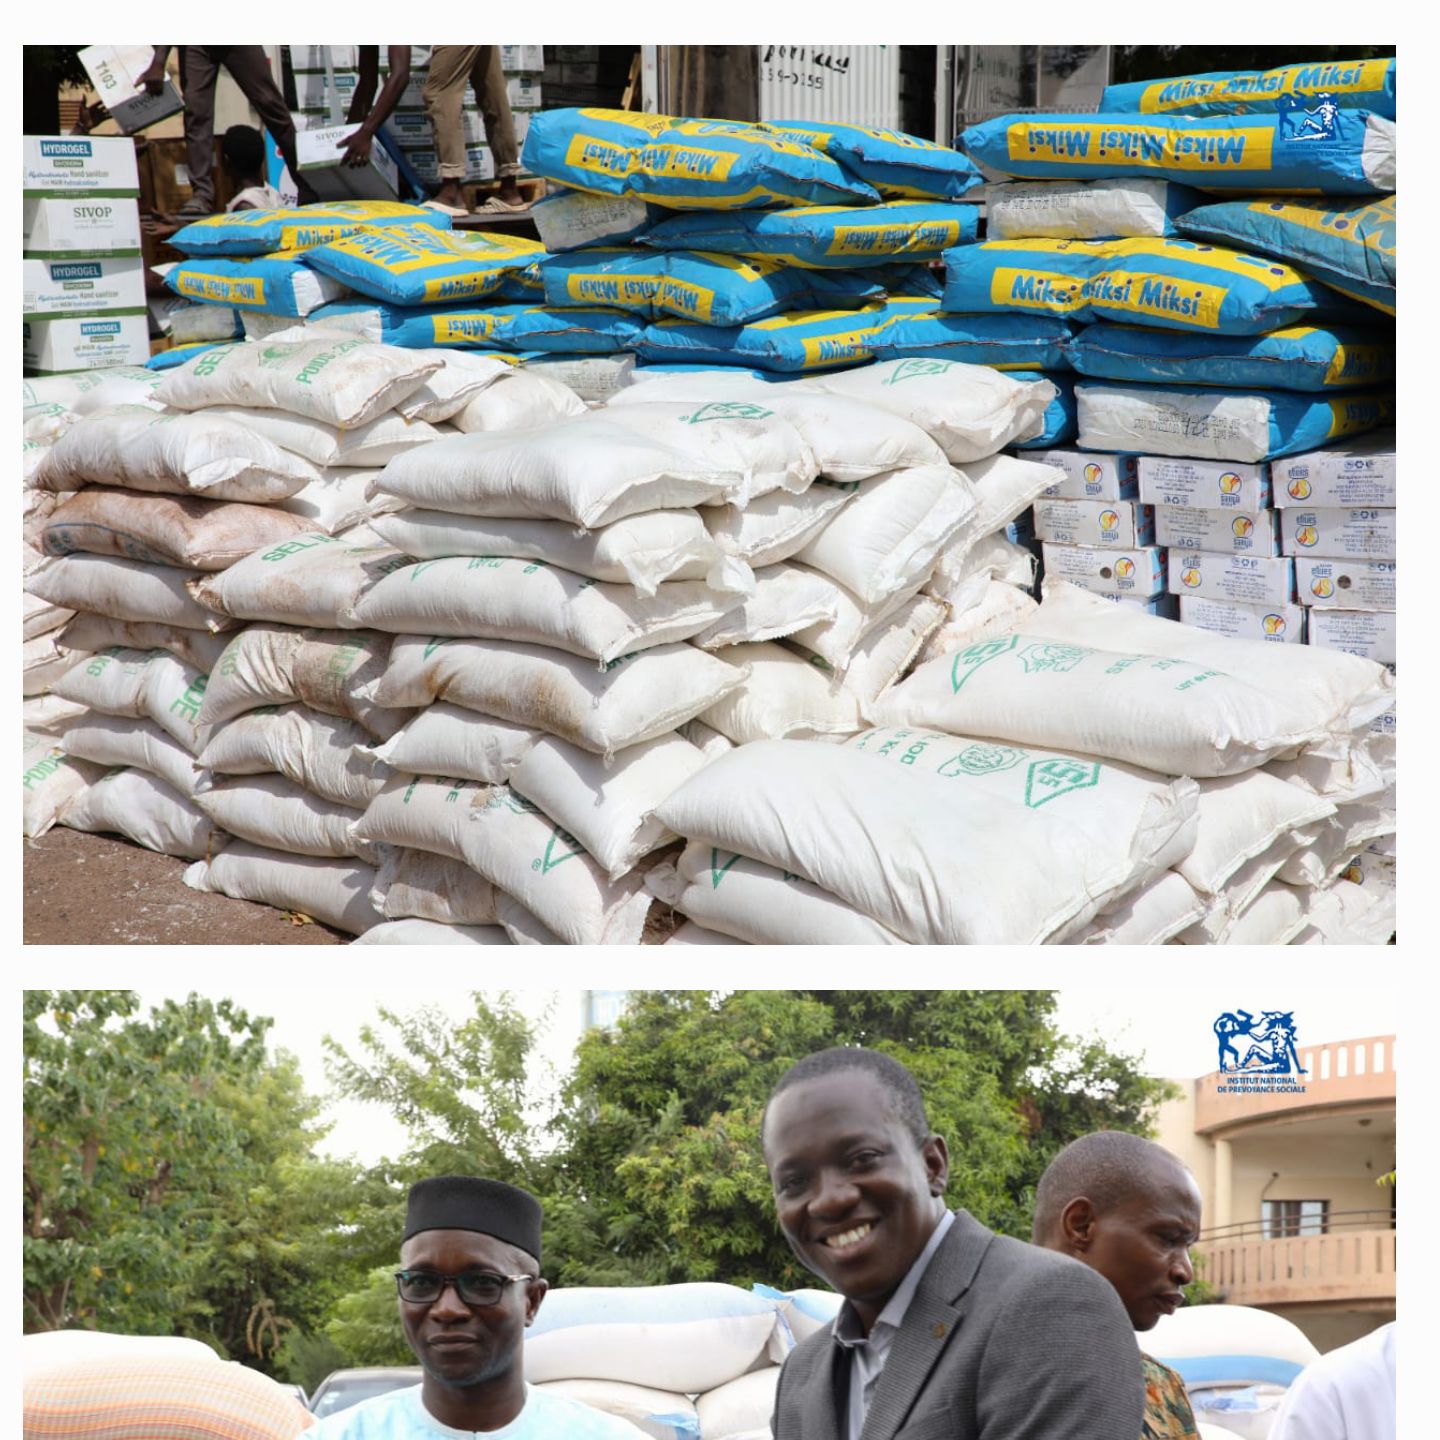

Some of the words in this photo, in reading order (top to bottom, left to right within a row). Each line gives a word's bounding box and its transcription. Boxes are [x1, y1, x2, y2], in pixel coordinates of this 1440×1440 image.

[1159, 79, 1216, 103] Miksi
[1293, 63, 1362, 89] Miksi
[43, 143, 90, 154] HYDROGEL
[1028, 130, 1091, 157] Miksi
[1098, 130, 1167, 159] Miksi
[1173, 134, 1246, 164] Miksi
[582, 143, 632, 172] Miksi
[671, 147, 720, 175] Miksi
[73, 206, 112, 218] SIVOP
[296, 229, 334, 246] Miksi
[52, 265, 99, 277] HYDROGEL
[439, 278, 478, 297] Miksi
[580, 280, 619, 300] Miksi
[663, 283, 699, 309] Miksi
[1012, 273, 1078, 304] Miksi
[1138, 280, 1203, 317] Miksi
[82, 323, 118, 333] HYDROGEL
[448, 320, 487, 337] Miksi
[194, 347, 234, 376] SEL
[261, 541, 319, 562] SEL
